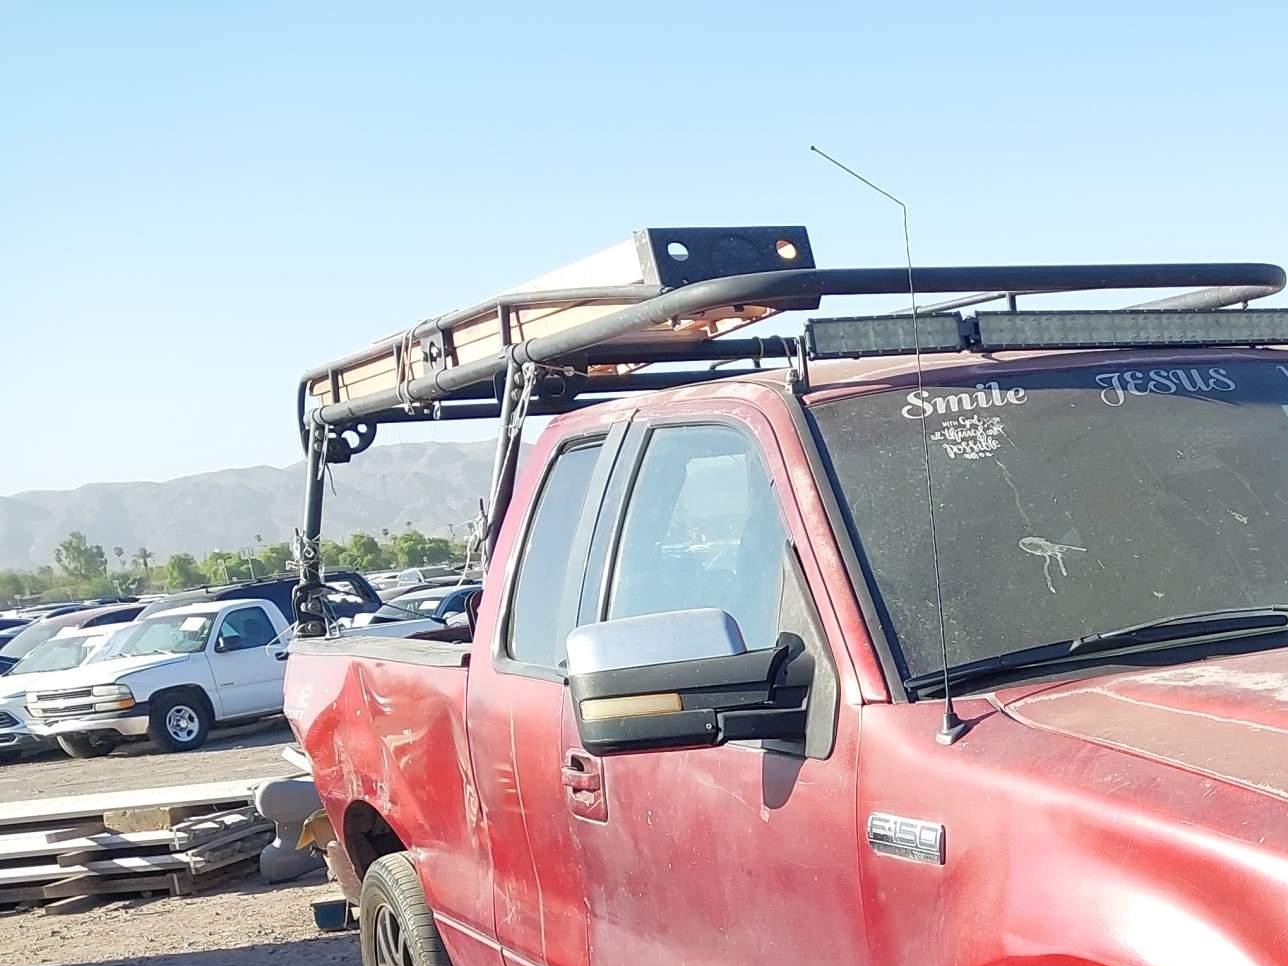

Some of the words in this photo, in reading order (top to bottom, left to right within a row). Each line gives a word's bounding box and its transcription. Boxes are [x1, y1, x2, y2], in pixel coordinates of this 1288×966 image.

[902, 382, 1028, 419] Smile
[1095, 367, 1236, 407] JESUS
[942, 436, 1002, 459] possible
